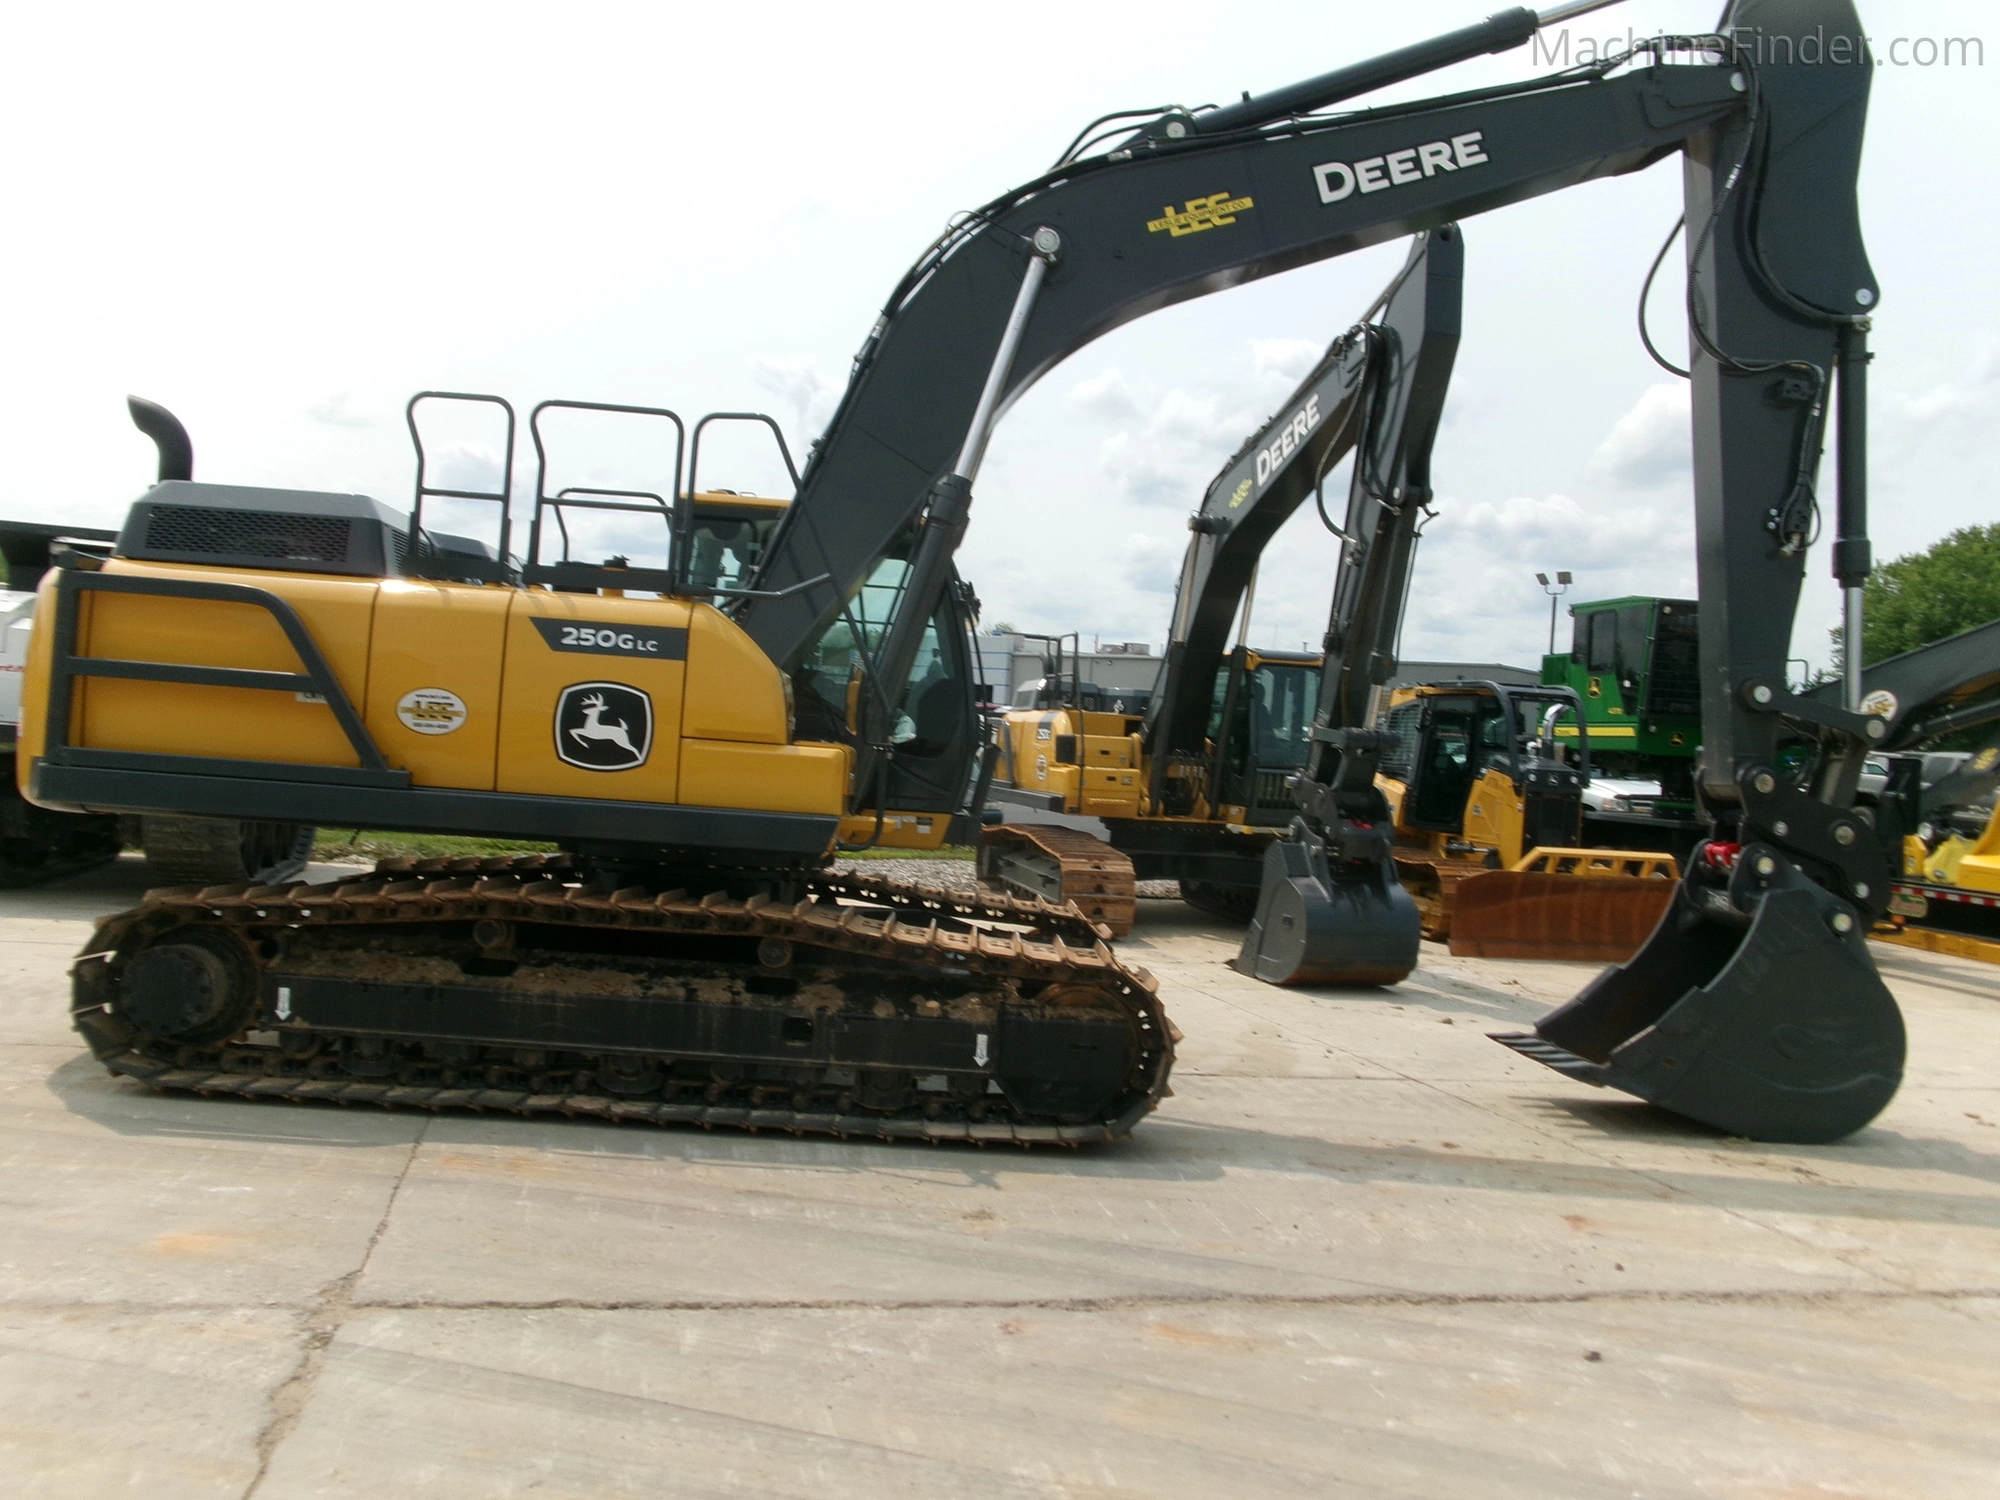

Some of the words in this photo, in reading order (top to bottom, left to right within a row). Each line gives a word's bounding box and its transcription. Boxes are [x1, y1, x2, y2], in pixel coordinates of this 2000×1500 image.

[1312, 131, 1489, 204] DEERE
[1164, 191, 1236, 237] LEC
[1256, 393, 1321, 487] DEERE
[561, 626, 634, 649] 250G
[637, 639, 658, 652] LC
